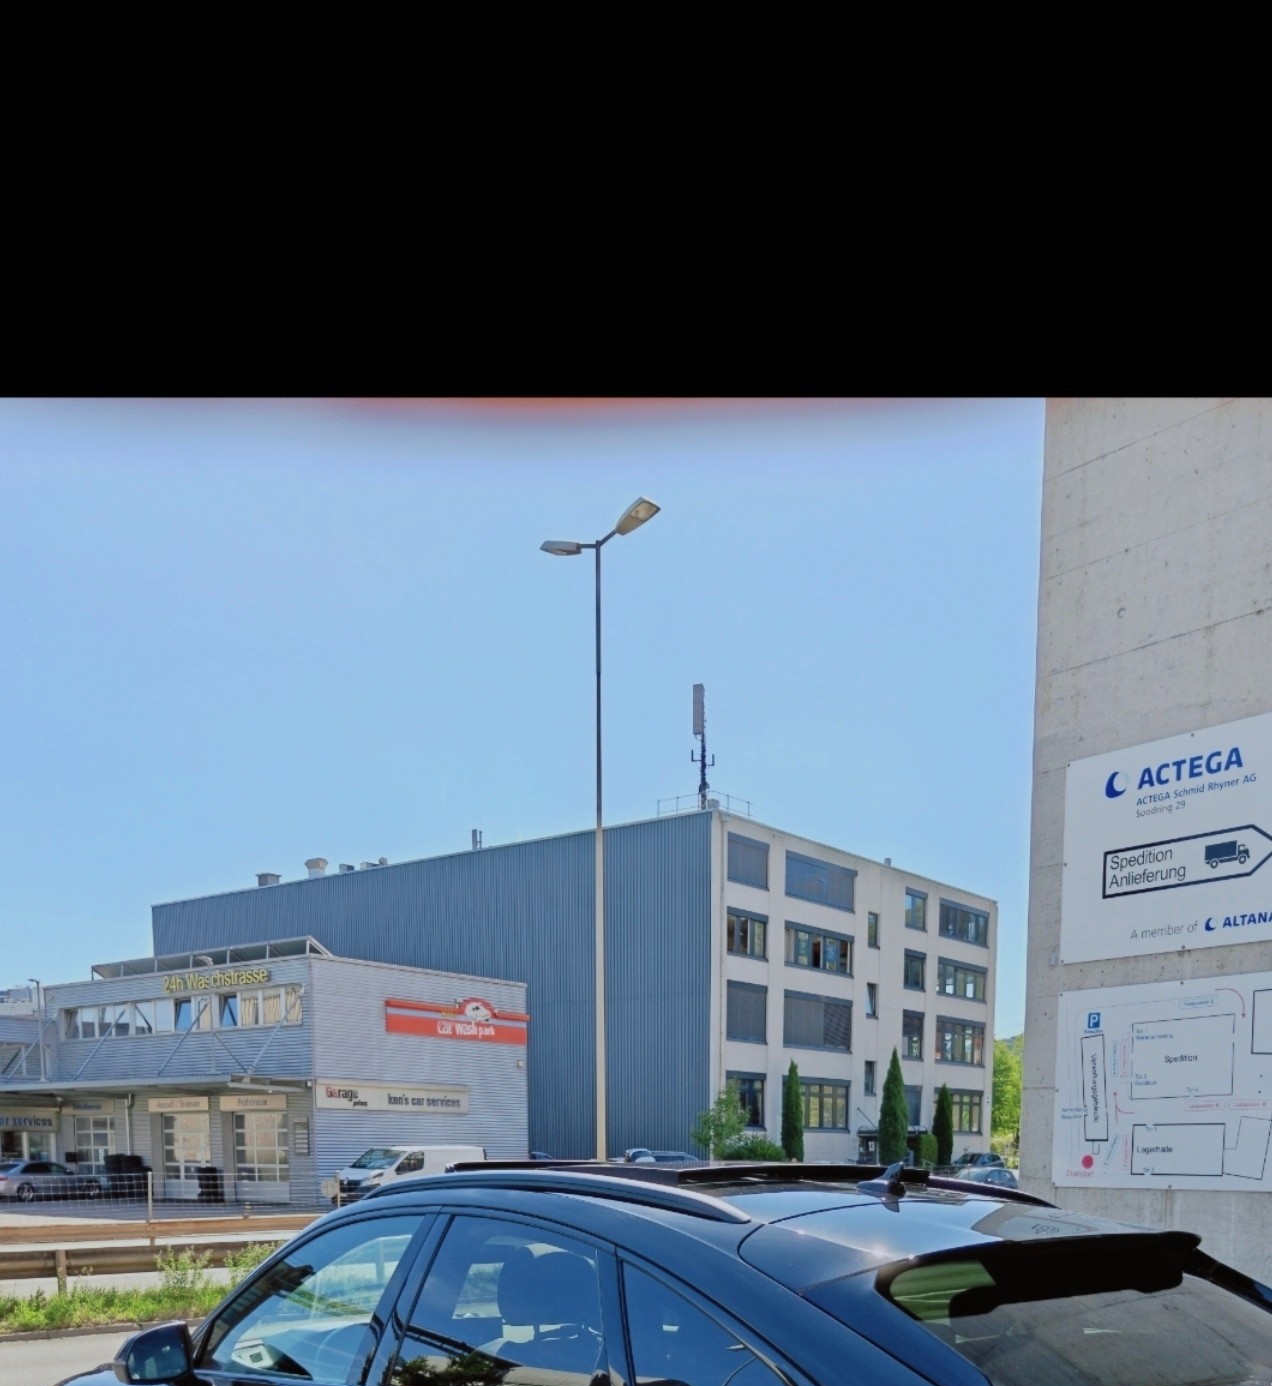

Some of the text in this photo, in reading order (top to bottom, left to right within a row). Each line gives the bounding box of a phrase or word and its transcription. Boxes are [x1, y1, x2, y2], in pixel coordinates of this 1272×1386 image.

[1136, 746, 1244, 790] ACTEGA
[1136, 772, 1257, 806] ACTEGA Schmid Rhyner AG
[1175, 800, 1186, 811] 29
[1110, 849, 1173, 872] Spedition
[1108, 866, 1186, 889] Anlieferung
[1129, 929, 1138, 940] A
[1140, 923, 1185, 939] member
[1186, 919, 1198, 933] of
[163, 975, 184, 993] 24h
[1164, 1054, 1198, 1064] Spedition
[325, 1086, 359, 1102] Garage
[411, 1096, 425, 1106] car
[426, 1095, 461, 1108] services
[12, 1114, 53, 1127] services
[1136, 1145, 1173, 1155] Lagerhalle
[1065, 1169, 1095, 1178] Standort
